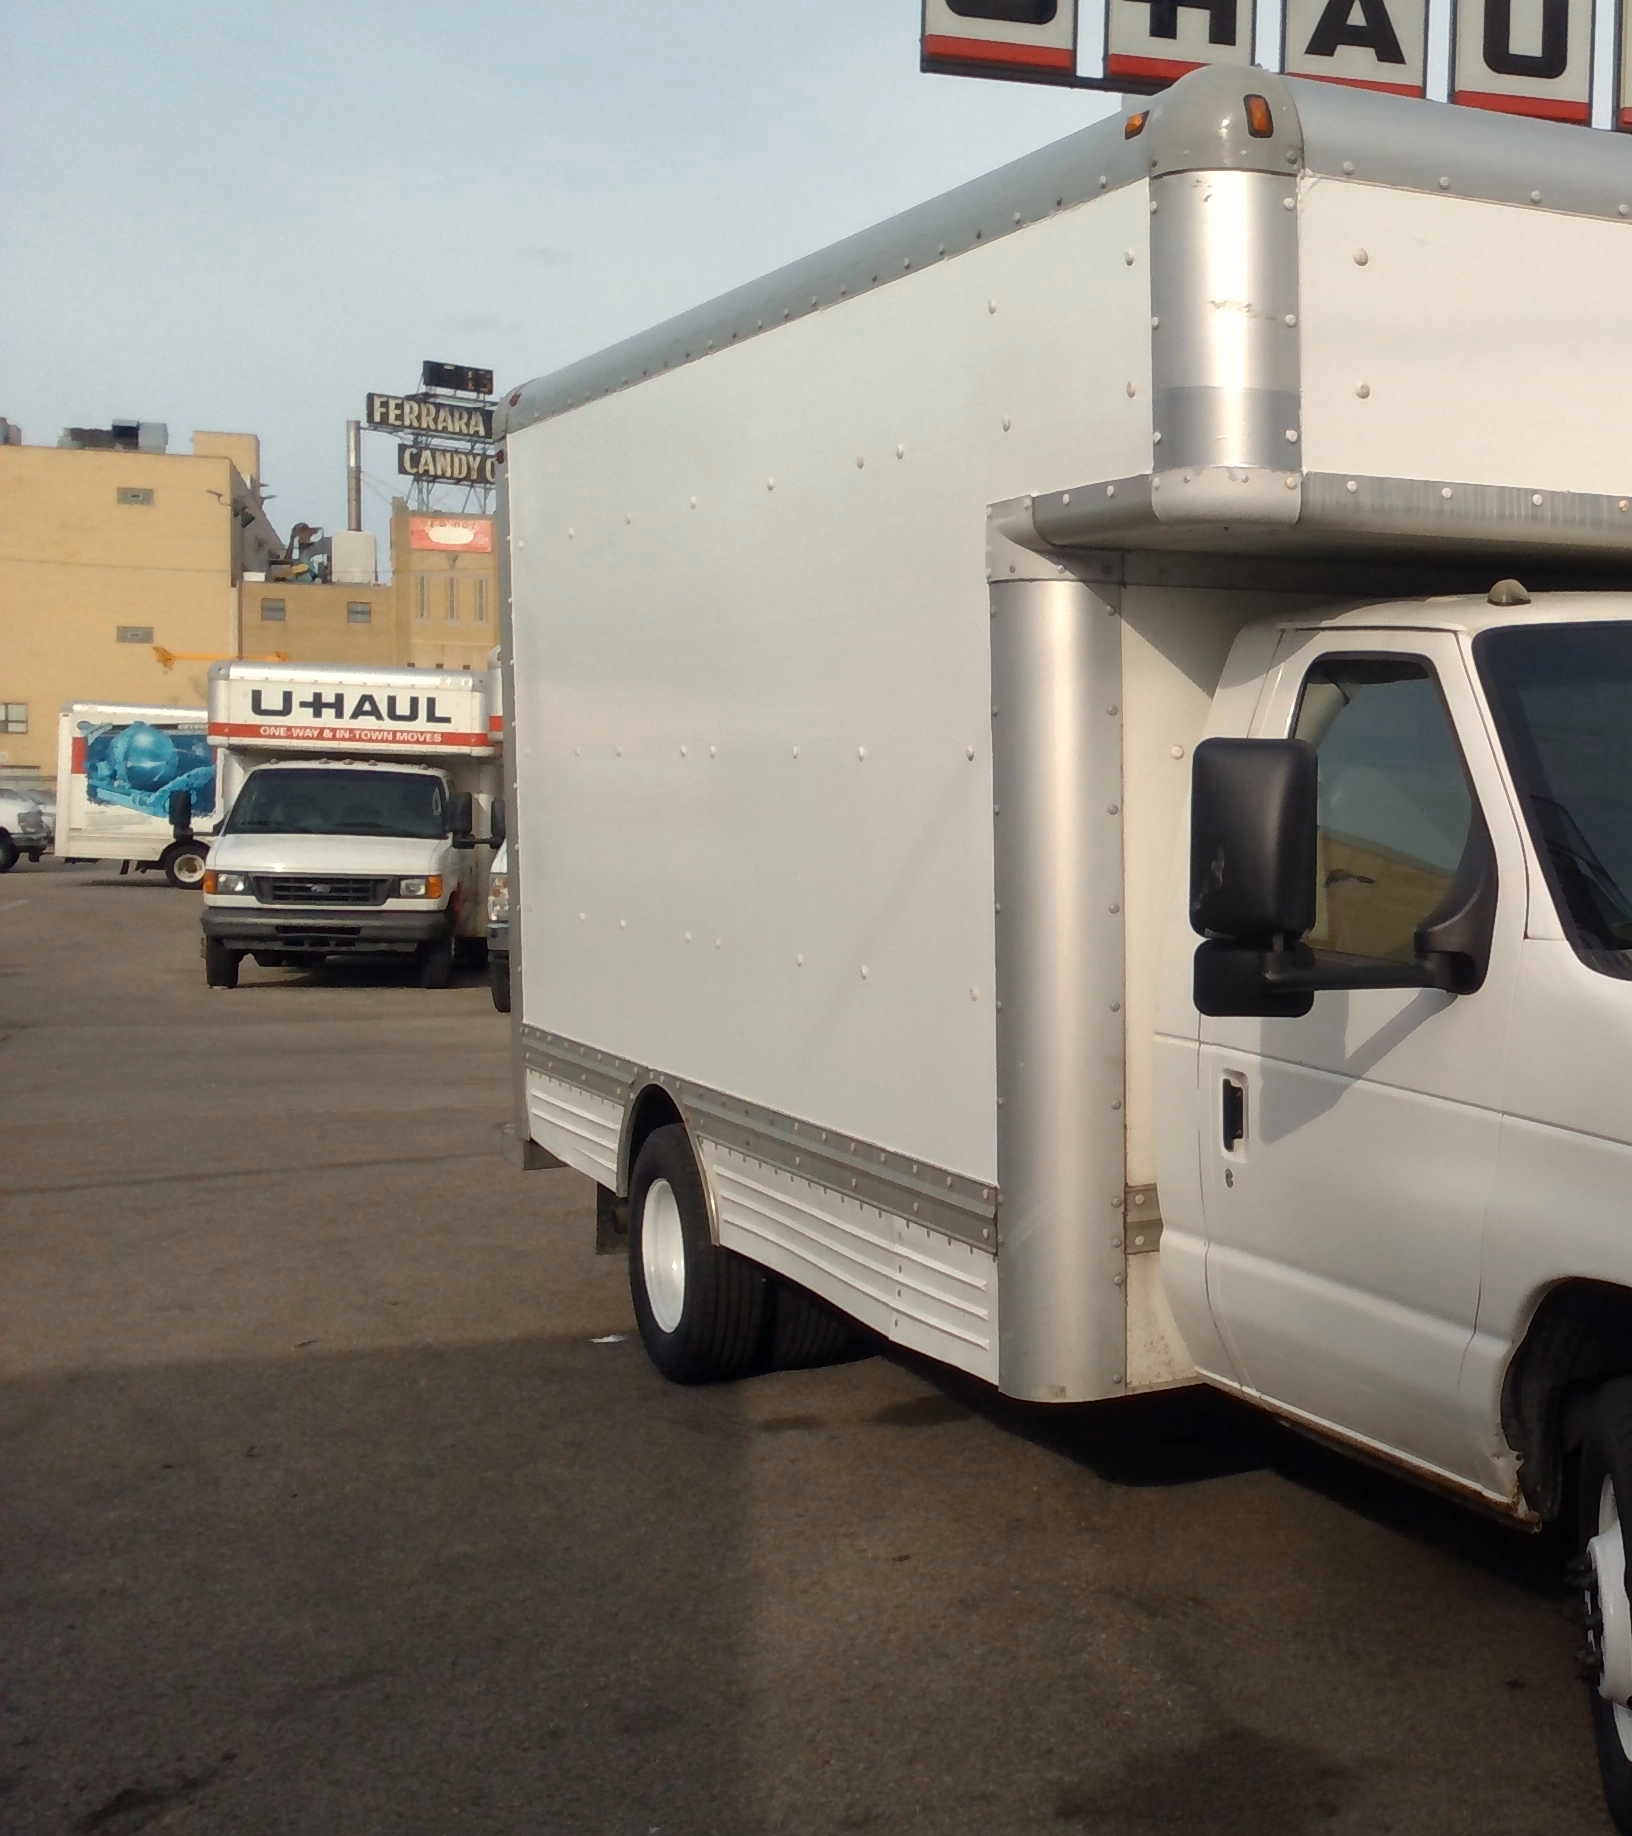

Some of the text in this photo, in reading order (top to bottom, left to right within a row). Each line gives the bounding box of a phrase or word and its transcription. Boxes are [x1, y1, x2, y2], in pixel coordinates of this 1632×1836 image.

[373, 395, 486, 436] FERRARA
[403, 447, 480, 480] CANDY
[251, 689, 452, 724] U-HAUL
[260, 726, 442, 743] ONE-WAY & IN-TOWN MOVES
